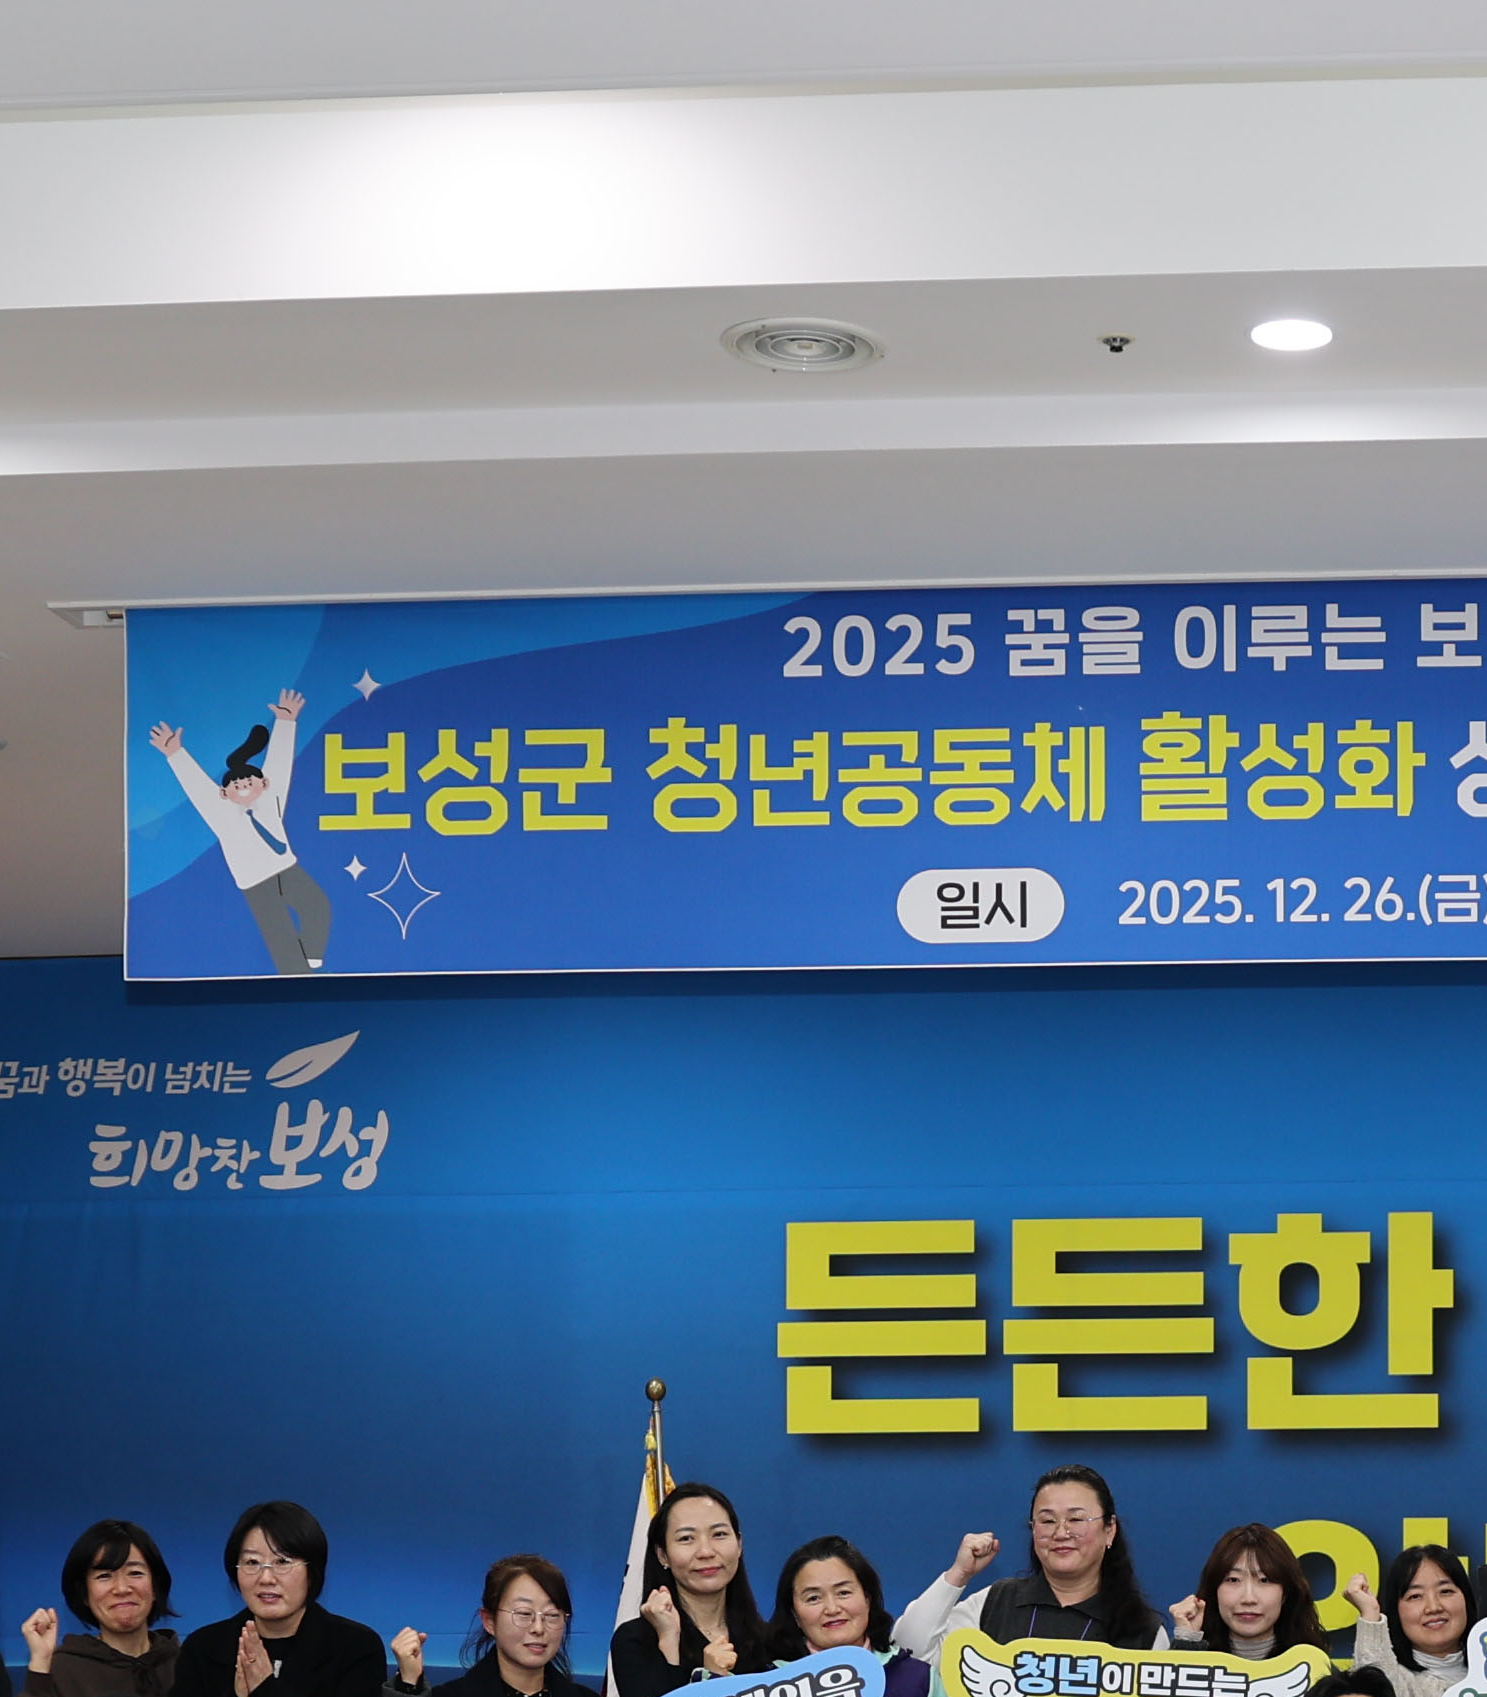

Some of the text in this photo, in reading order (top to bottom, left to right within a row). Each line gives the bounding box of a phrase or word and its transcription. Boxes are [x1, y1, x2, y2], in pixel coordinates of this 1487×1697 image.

[782, 613, 975, 678] 2025
[1004, 606, 1144, 677] 꿈을
[1174, 603, 1387, 672] 이루는
[318, 718, 613, 833] 보성군
[645, 707, 1106, 833] 청년공동체
[1139, 711, 1427, 822] 활성화
[935, 880, 1027, 930] 일시
[1117, 877, 1255, 926] 2025.
[57, 1057, 156, 1097] 행복이
[164, 1061, 252, 1094] 넘치는
[88, 1098, 390, 1190] 희망찬 보성
[777, 1211, 1454, 1434] 든든한
[1014, 1651, 1134, 1697] 청년이
